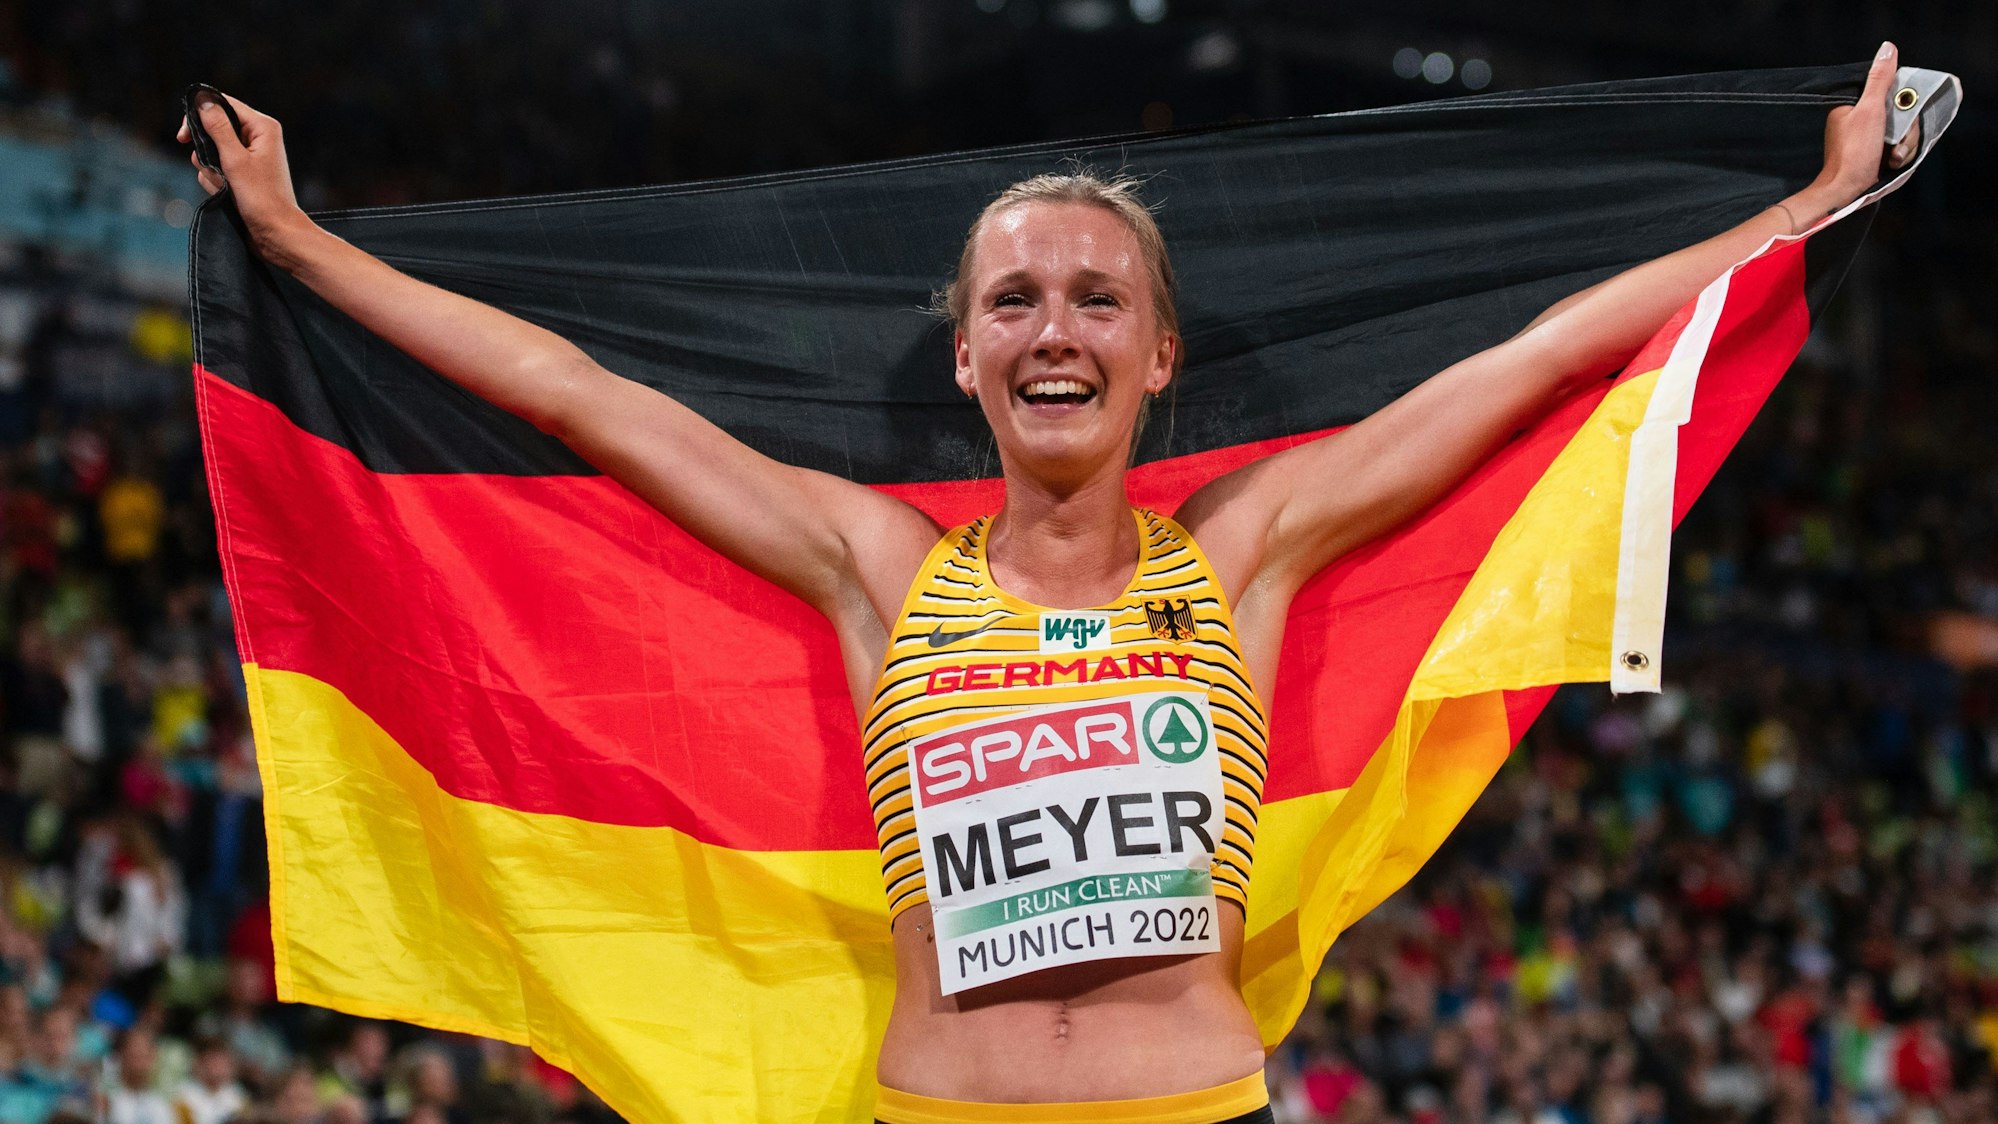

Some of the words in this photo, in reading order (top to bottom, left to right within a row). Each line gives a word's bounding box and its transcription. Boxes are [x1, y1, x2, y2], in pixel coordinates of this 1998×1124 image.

[927, 652, 1193, 695] GERMANY
[921, 712, 1132, 796] SPAR
[932, 791, 1215, 897] MEYER
[1003, 903, 1010, 920] I
[1017, 887, 1071, 915] RUN
[958, 912, 1115, 978] MUNICH
[1130, 907, 1210, 944] 2022
